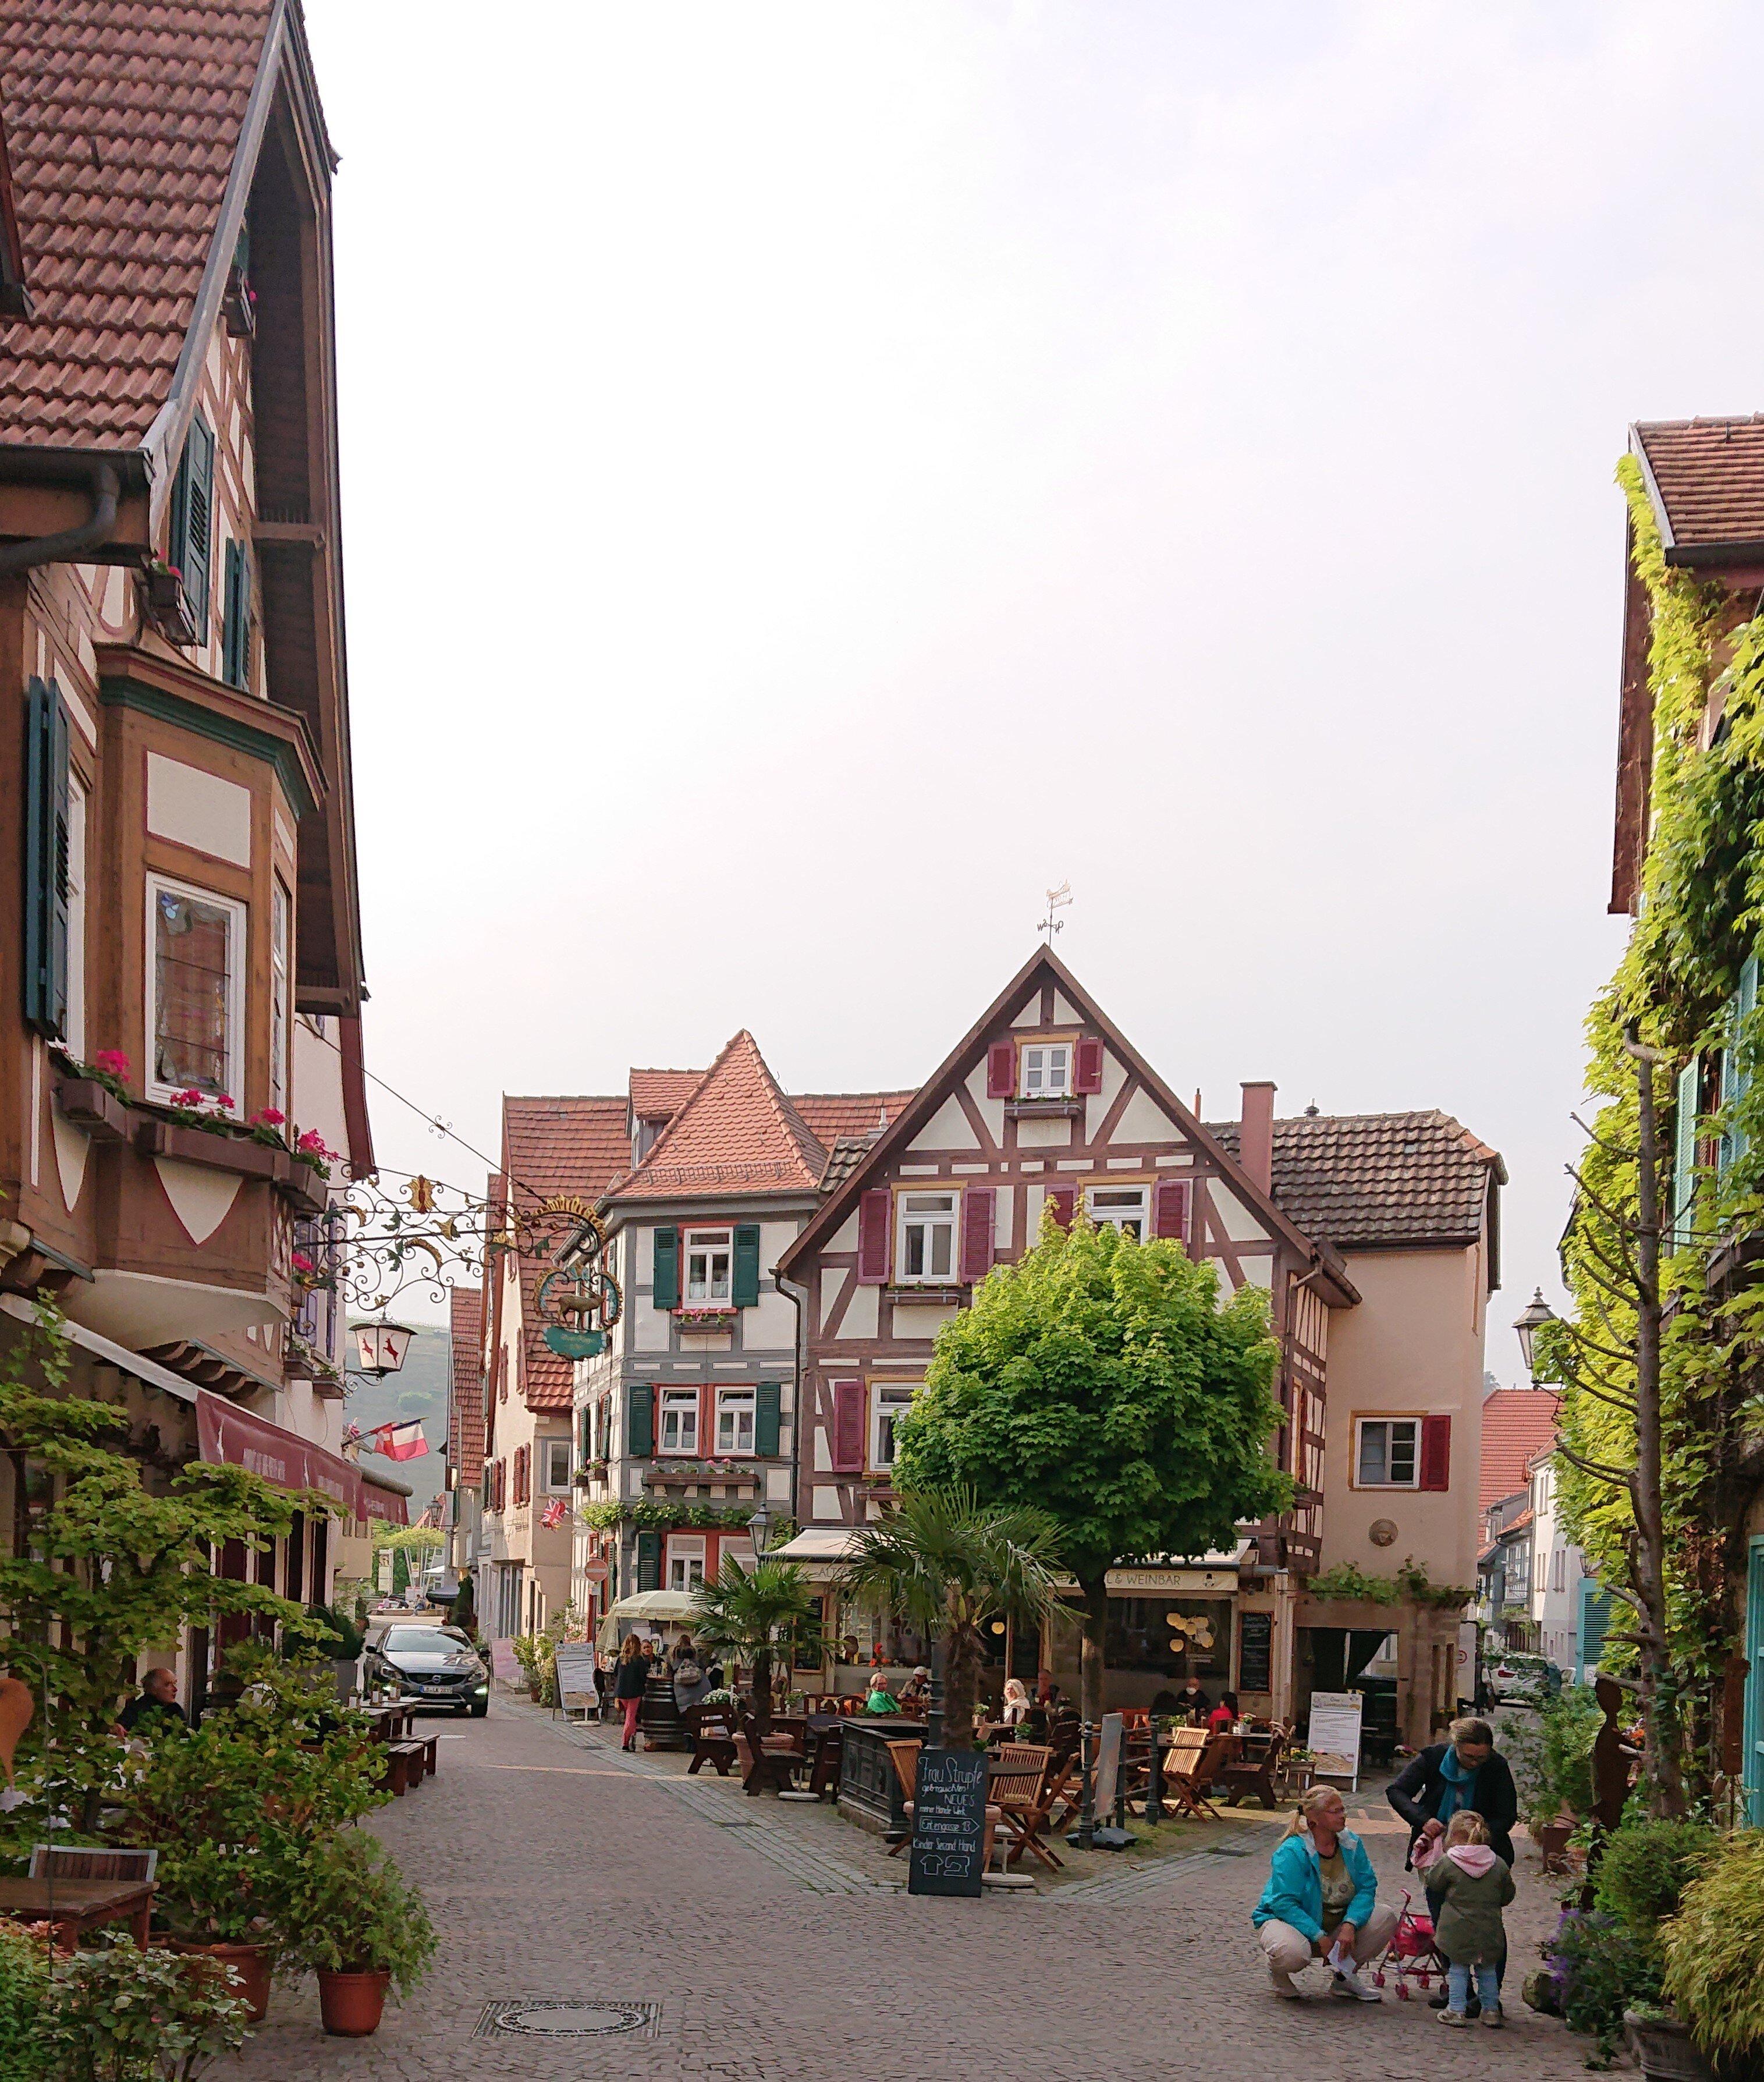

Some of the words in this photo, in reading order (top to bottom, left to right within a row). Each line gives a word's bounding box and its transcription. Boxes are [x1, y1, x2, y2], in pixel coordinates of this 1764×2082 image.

[1127, 1574, 1181, 1585] WEINBAR
[918, 1757, 944, 1782] Frau
[944, 1794, 975, 1807] NEUES
[913, 1838, 934, 1850] Kinder
[936, 1838, 956, 1851] Second
[959, 1839, 976, 1852] Hand
